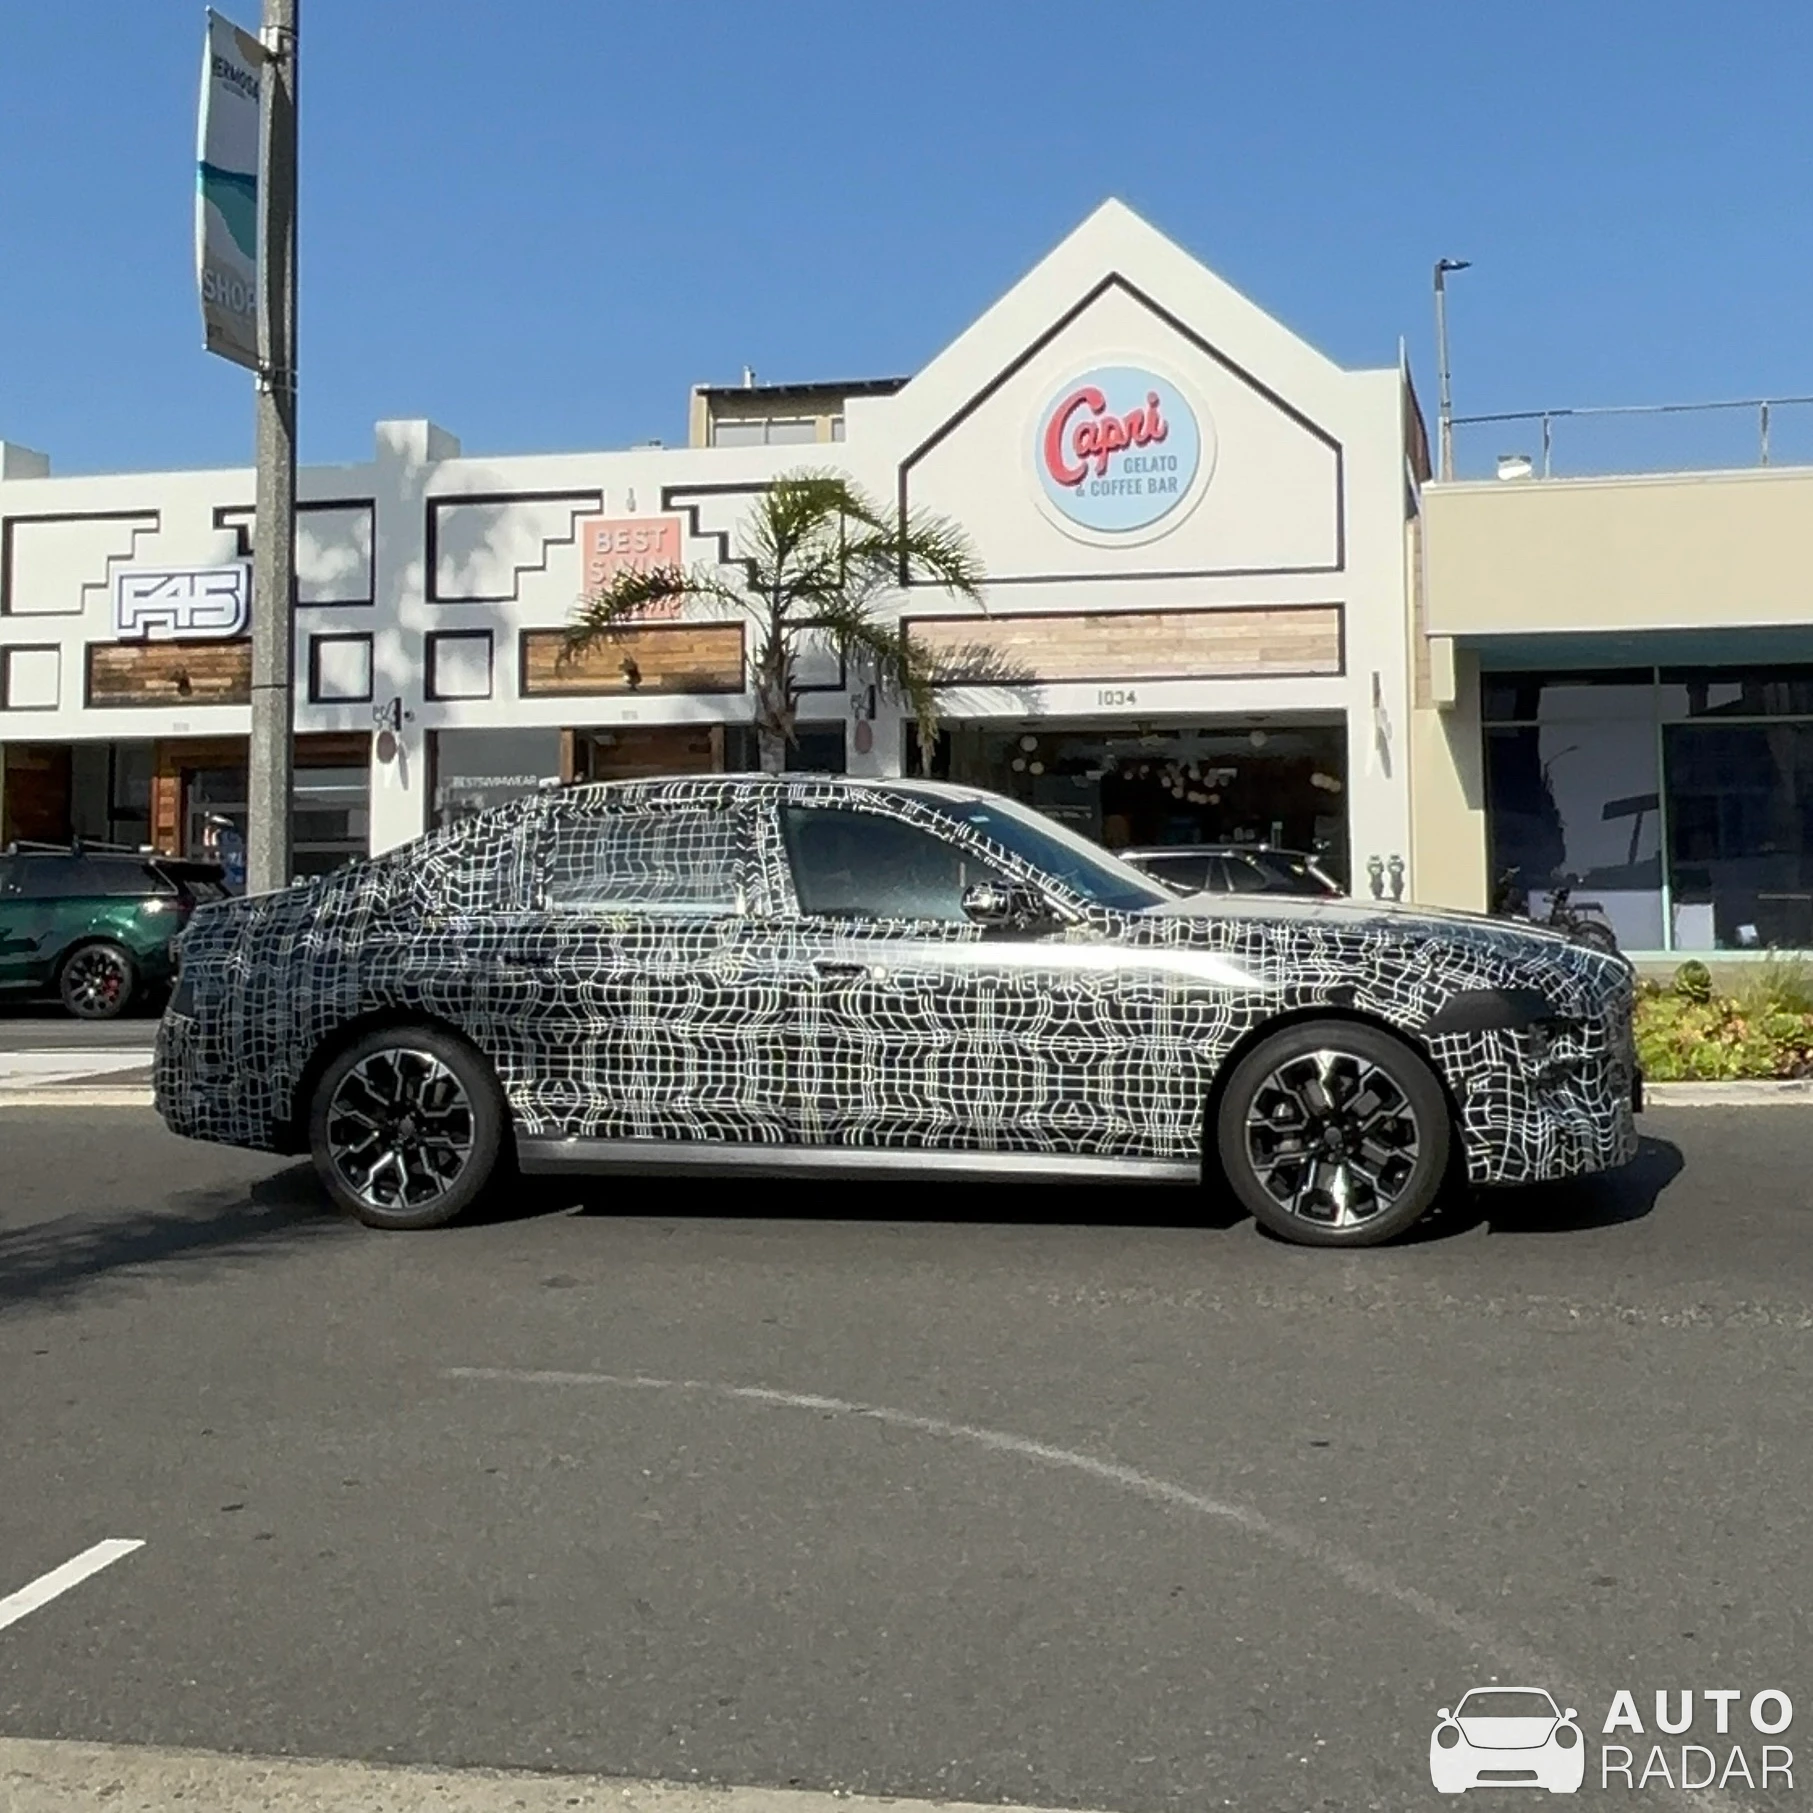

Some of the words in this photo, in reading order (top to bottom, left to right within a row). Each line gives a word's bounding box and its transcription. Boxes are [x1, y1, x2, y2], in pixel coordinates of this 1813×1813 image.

[1044, 385, 1168, 487] Capri
[1123, 455, 1178, 474] GELATO
[1090, 478, 1143, 497] COFFEE
[1147, 476, 1178, 494] BAR
[595, 528, 668, 554] BEST
[118, 570, 241, 630] F45
[1097, 689, 1137, 706] 1034
